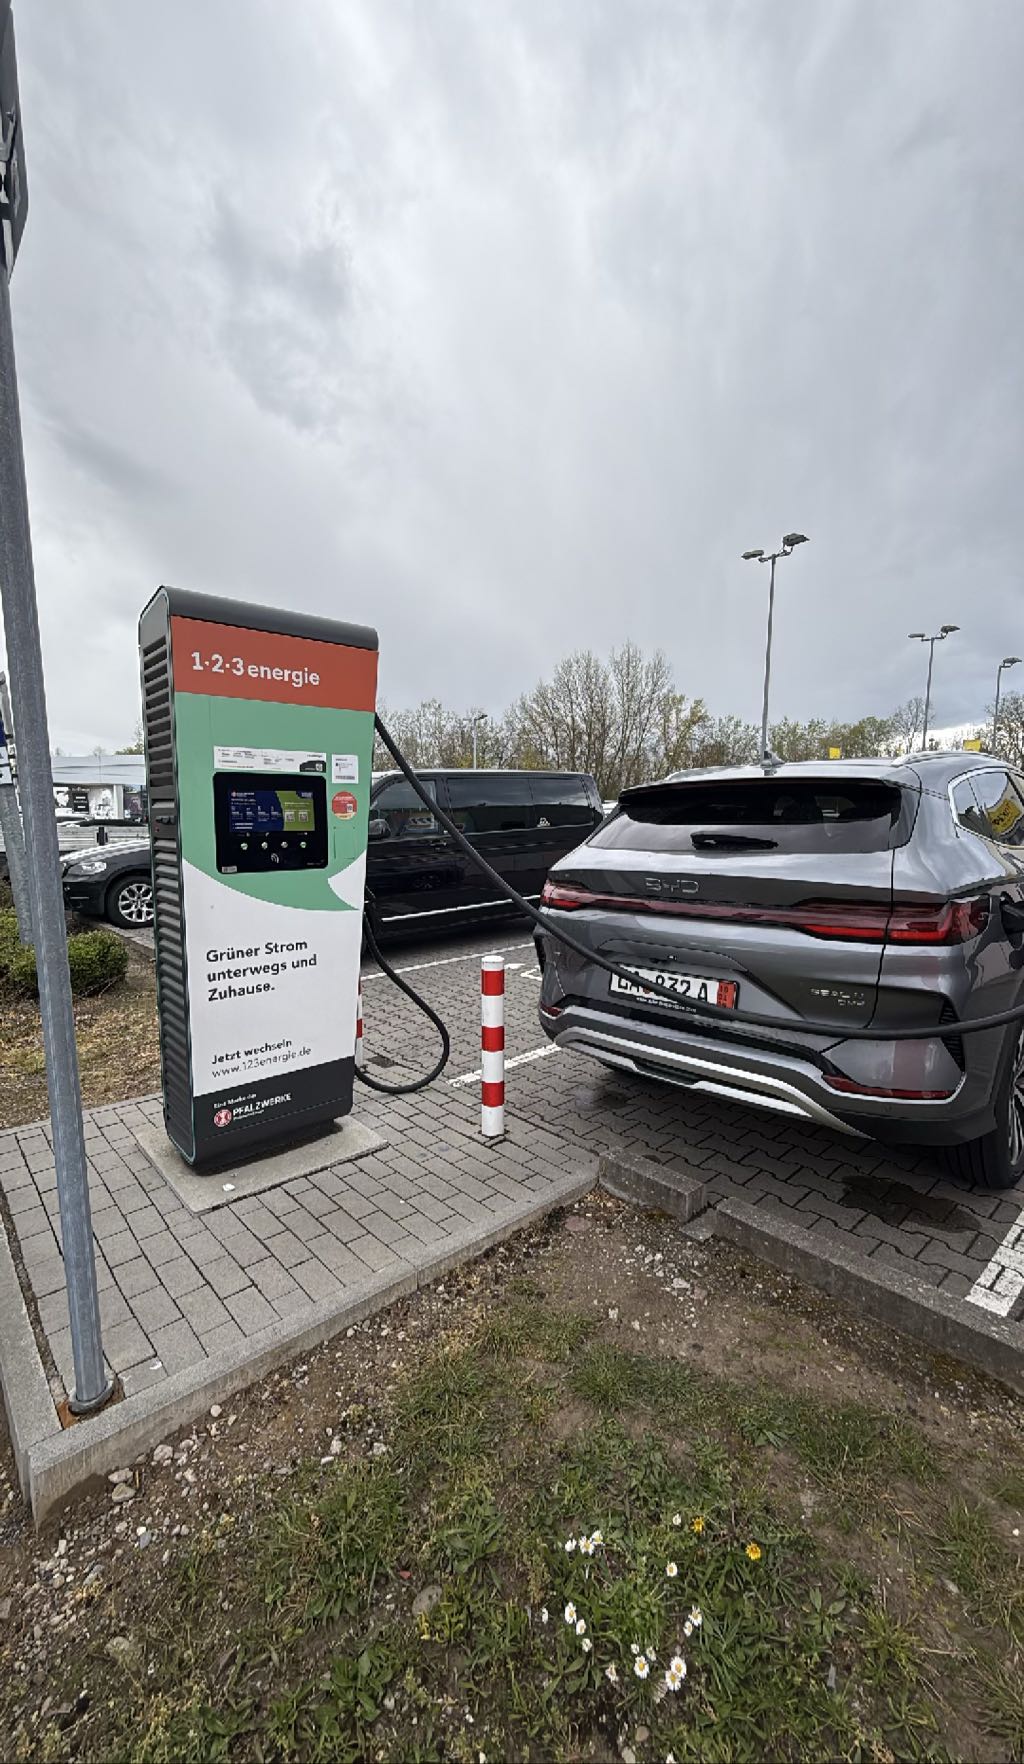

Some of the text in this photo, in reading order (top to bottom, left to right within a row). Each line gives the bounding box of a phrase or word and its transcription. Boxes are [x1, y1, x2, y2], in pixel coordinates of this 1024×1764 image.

[247, 666, 320, 688] energie
[645, 877, 699, 893] BYD
[206, 941, 308, 963] Grüner Strom
[207, 953, 317, 982] unterwegs und
[208, 982, 275, 1002] Zuhause.
[211, 1039, 292, 1065] Jetzt wechseln
[211, 1046, 312, 1078] www.123energie.de
[232, 1092, 292, 1116] PFALZWERKE
